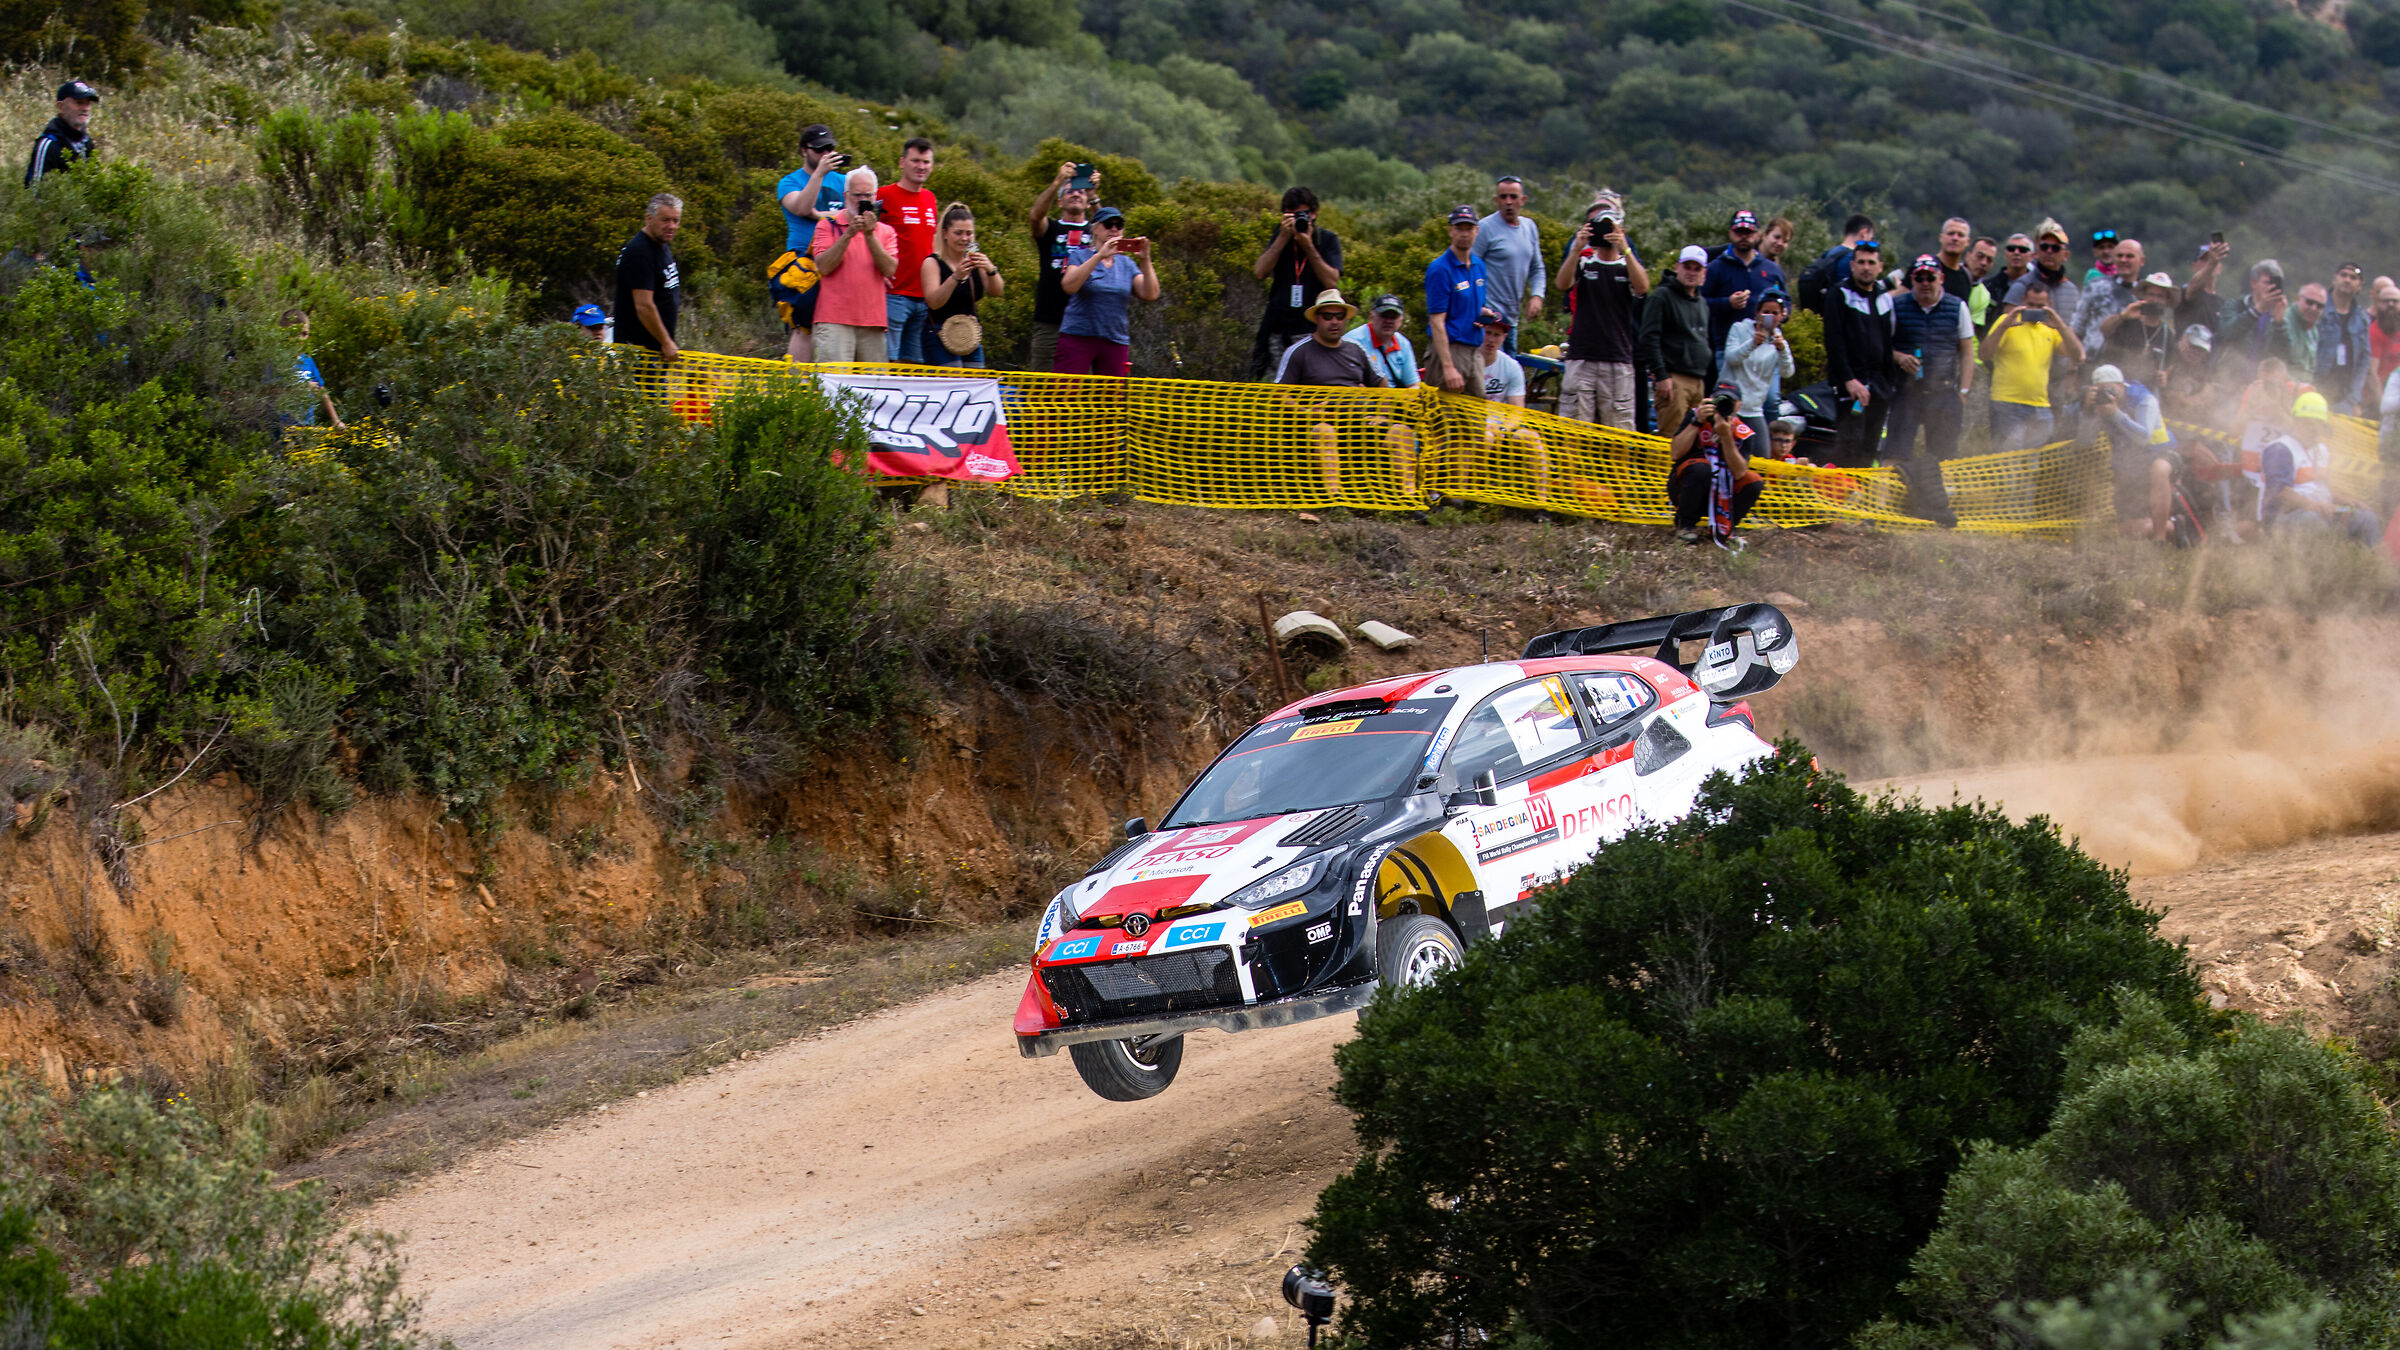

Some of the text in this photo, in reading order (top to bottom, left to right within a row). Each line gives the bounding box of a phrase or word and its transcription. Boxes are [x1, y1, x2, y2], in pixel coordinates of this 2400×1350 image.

[1381, 707, 1429, 715] Racing
[1296, 721, 1357, 737] PIRELLI
[1477, 812, 1529, 837] SARDEGNA
[1562, 793, 1632, 840] DENSO
[1126, 846, 1234, 871] DENSO
[1149, 865, 1194, 877] Microsoft
[1347, 840, 1396, 917] Panasonic
[1251, 903, 1302, 925] PIRELLI
[1306, 924, 1332, 941] OMP
